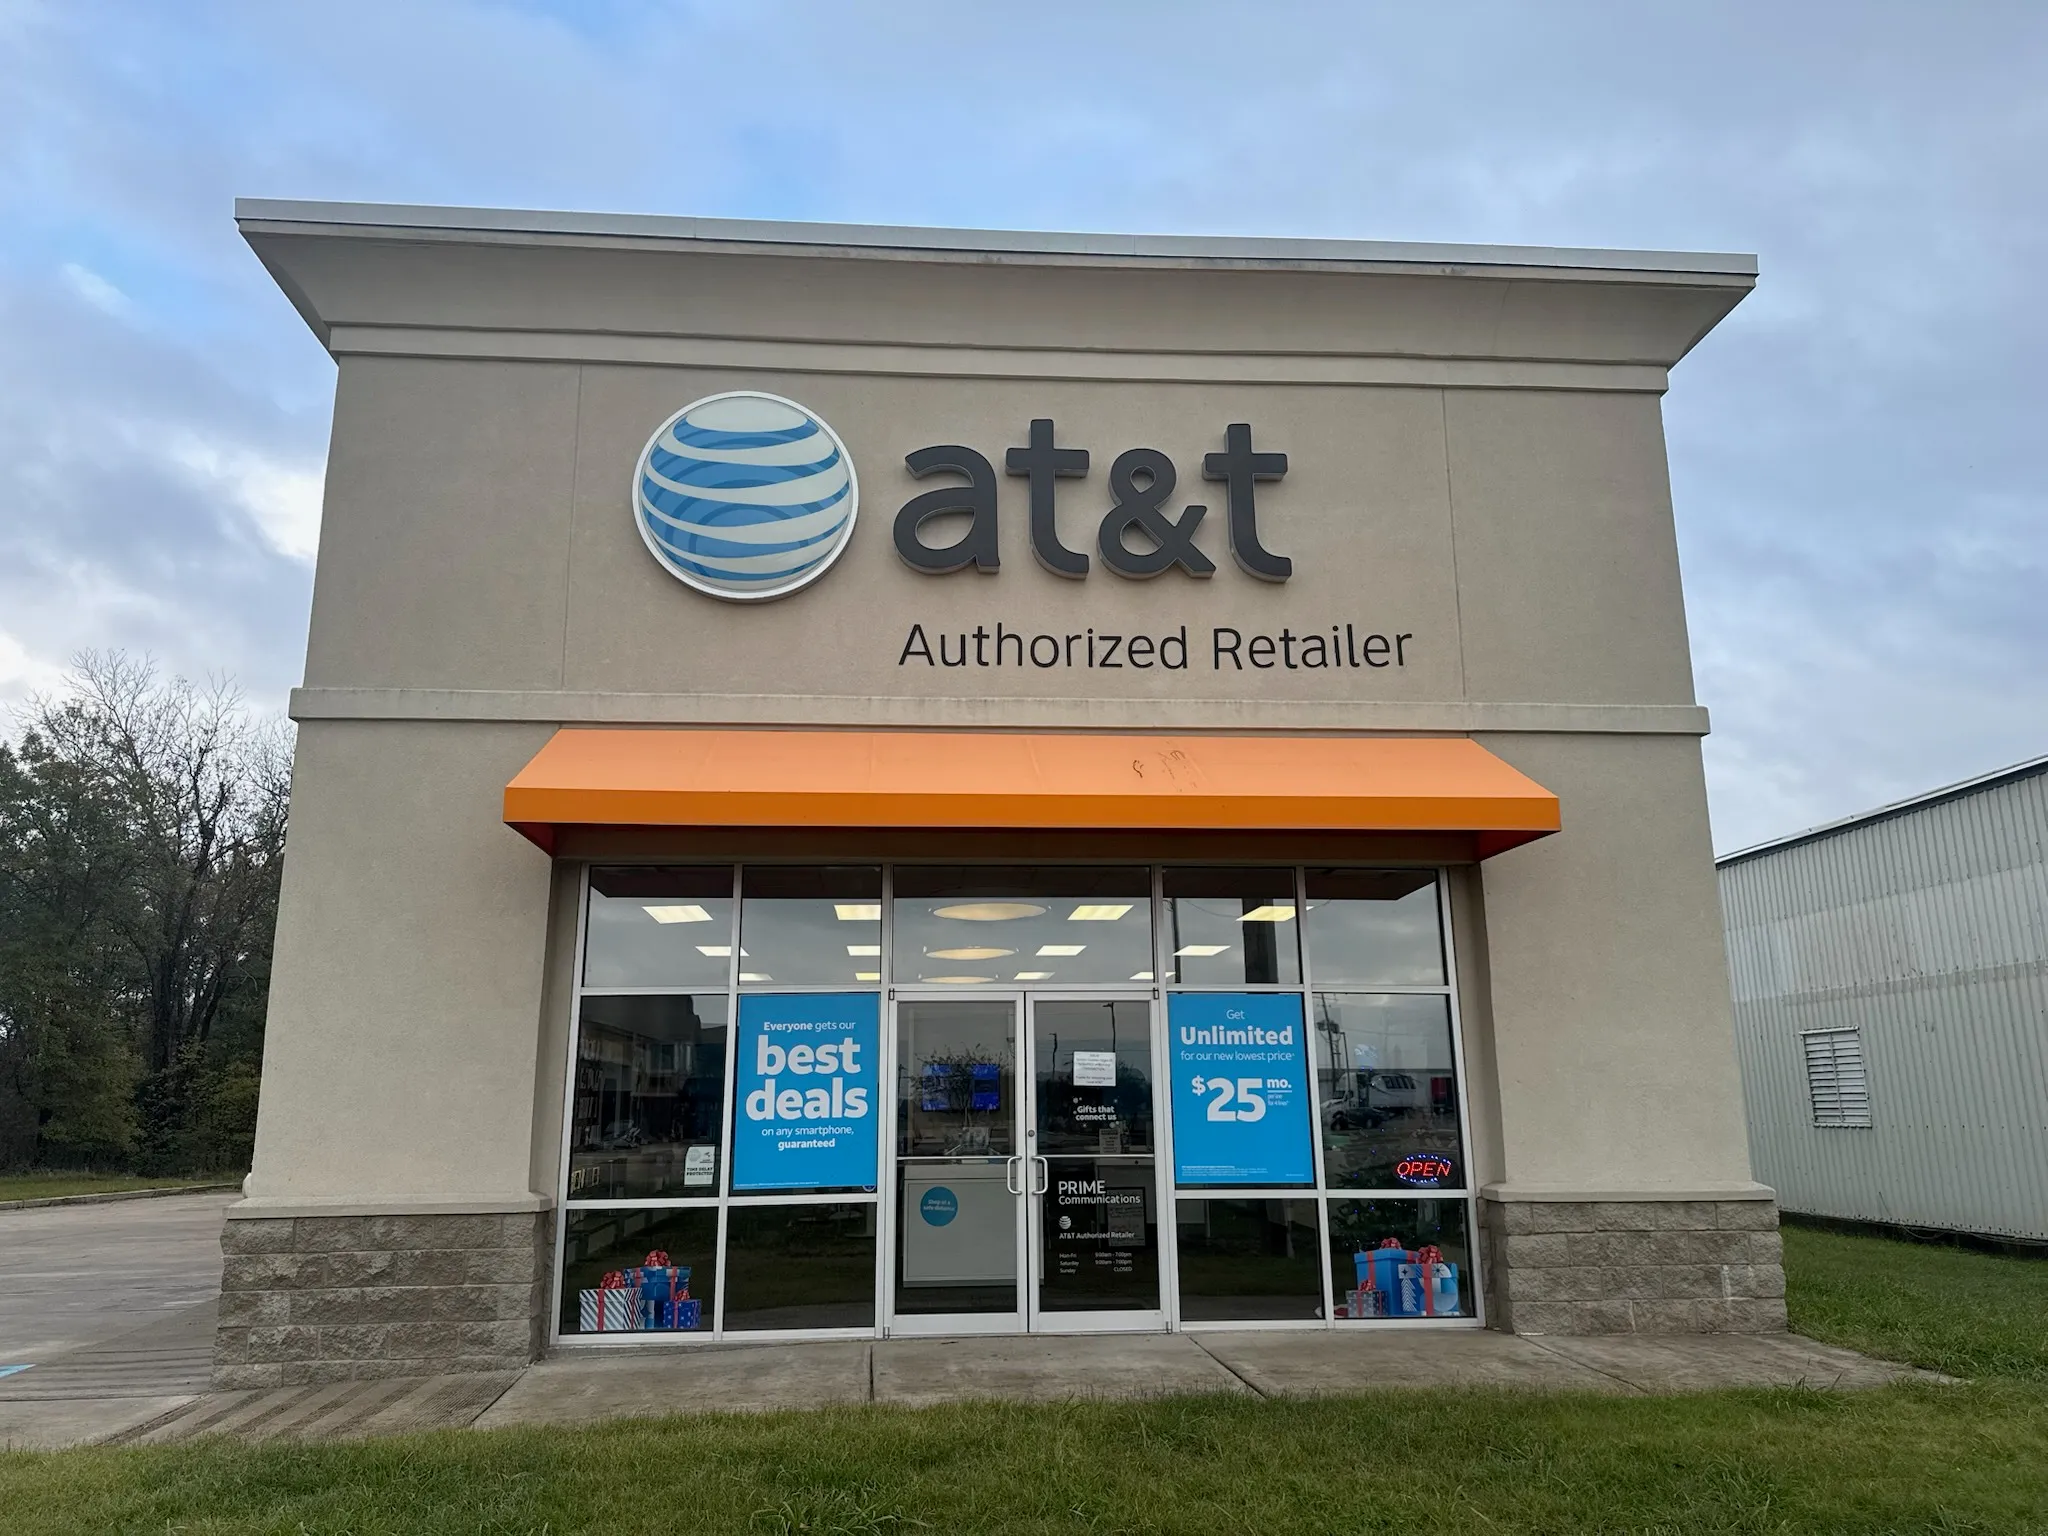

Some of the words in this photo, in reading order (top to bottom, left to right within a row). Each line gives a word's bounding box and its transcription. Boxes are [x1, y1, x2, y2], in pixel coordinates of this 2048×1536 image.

[893, 418, 1292, 583] at&t
[899, 623, 1188, 670] Authorized
[1213, 624, 1413, 671] Retailer
[1226, 1009, 1245, 1020] Get
[763, 1021, 813, 1032] Everyone
[815, 1021, 837, 1032] gets
[839, 1021, 856, 1030] our
[1181, 1025, 1293, 1045] Unlimited
[757, 1034, 861, 1075] best
[1181, 1050, 1194, 1060] for
[1196, 1052, 1212, 1060] our
[1214, 1052, 1235, 1060] new
[1235, 1051, 1266, 1060] lowest
[1267, 1078, 1292, 1088] mo.
[746, 1077, 868, 1121] deals
[762, 1128, 774, 1136] on
[776, 1128, 793, 1139] any
[795, 1125, 854, 1138] smartphone,
[778, 1139, 835, 1151] guaranteed
[1397, 1162, 1451, 1176] OPEN
[1058, 1180, 1106, 1194] PRIME
[1058, 1194, 1141, 1205] Communications
